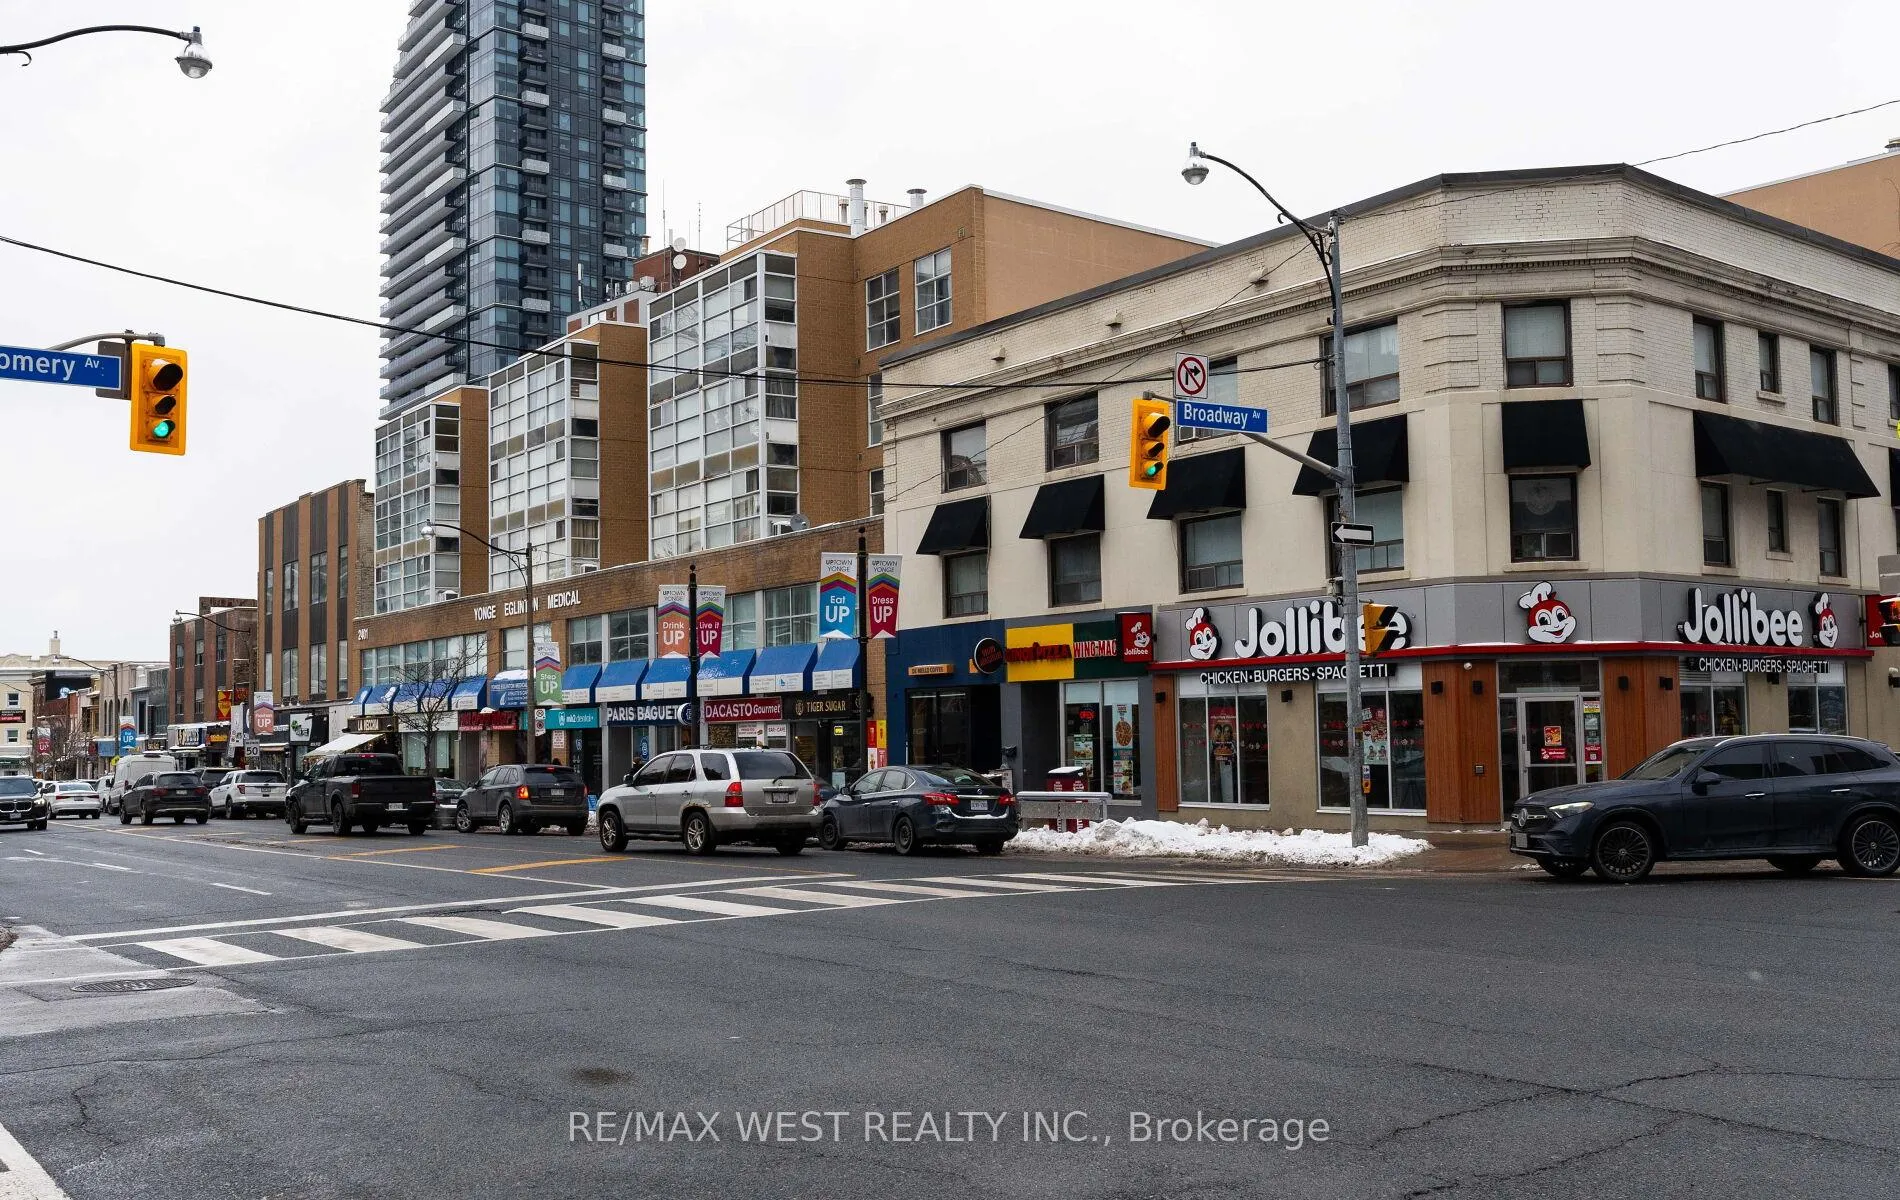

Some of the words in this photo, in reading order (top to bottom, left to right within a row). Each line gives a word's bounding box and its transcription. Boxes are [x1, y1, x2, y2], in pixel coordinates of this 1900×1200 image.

[0, 352, 76, 381] omery
[84, 357, 100, 368] Av
[1183, 403, 1248, 429] Broadway
[1252, 410, 1261, 420] Av
[473, 605, 496, 621] YONGE
[504, 597, 539, 616] EGLINTN
[547, 590, 581, 610] MEDICAL
[830, 595, 846, 604] Eat
[872, 596, 894, 604] Dress
[825, 605, 850, 623] UP
[873, 606, 893, 624] UP
[1684, 587, 1804, 647] Jollibee
[662, 621, 684, 629] Drink
[1234, 599, 1412, 658] Jollibe
[663, 630, 685, 645] UP
[701, 631, 718, 645] UP
[1124, 648, 1149, 656] Jollibee
[1698, 657, 1738, 673] CHICKEN
[1742, 658, 1782, 673] BURGERS
[1786, 660, 1830, 674] SPAGHETTI
[540, 673, 557, 682] Step
[1199, 670, 1248, 685] CHICKEN
[1253, 667, 1310, 683] BURGERS
[1316, 664, 1388, 681] SPAGETTI
[539, 682, 559, 694] UP
[607, 707, 635, 722] PARIS
[637, 705, 679, 721] BAGUET
[705, 703, 753, 718] DACASTO
[753, 703, 781, 714] Gourmet
[806, 701, 824, 713] TIGER
[825, 700, 846, 712] SUGAR
[257, 719, 271, 728] UP
[246, 746, 258, 756] 50
